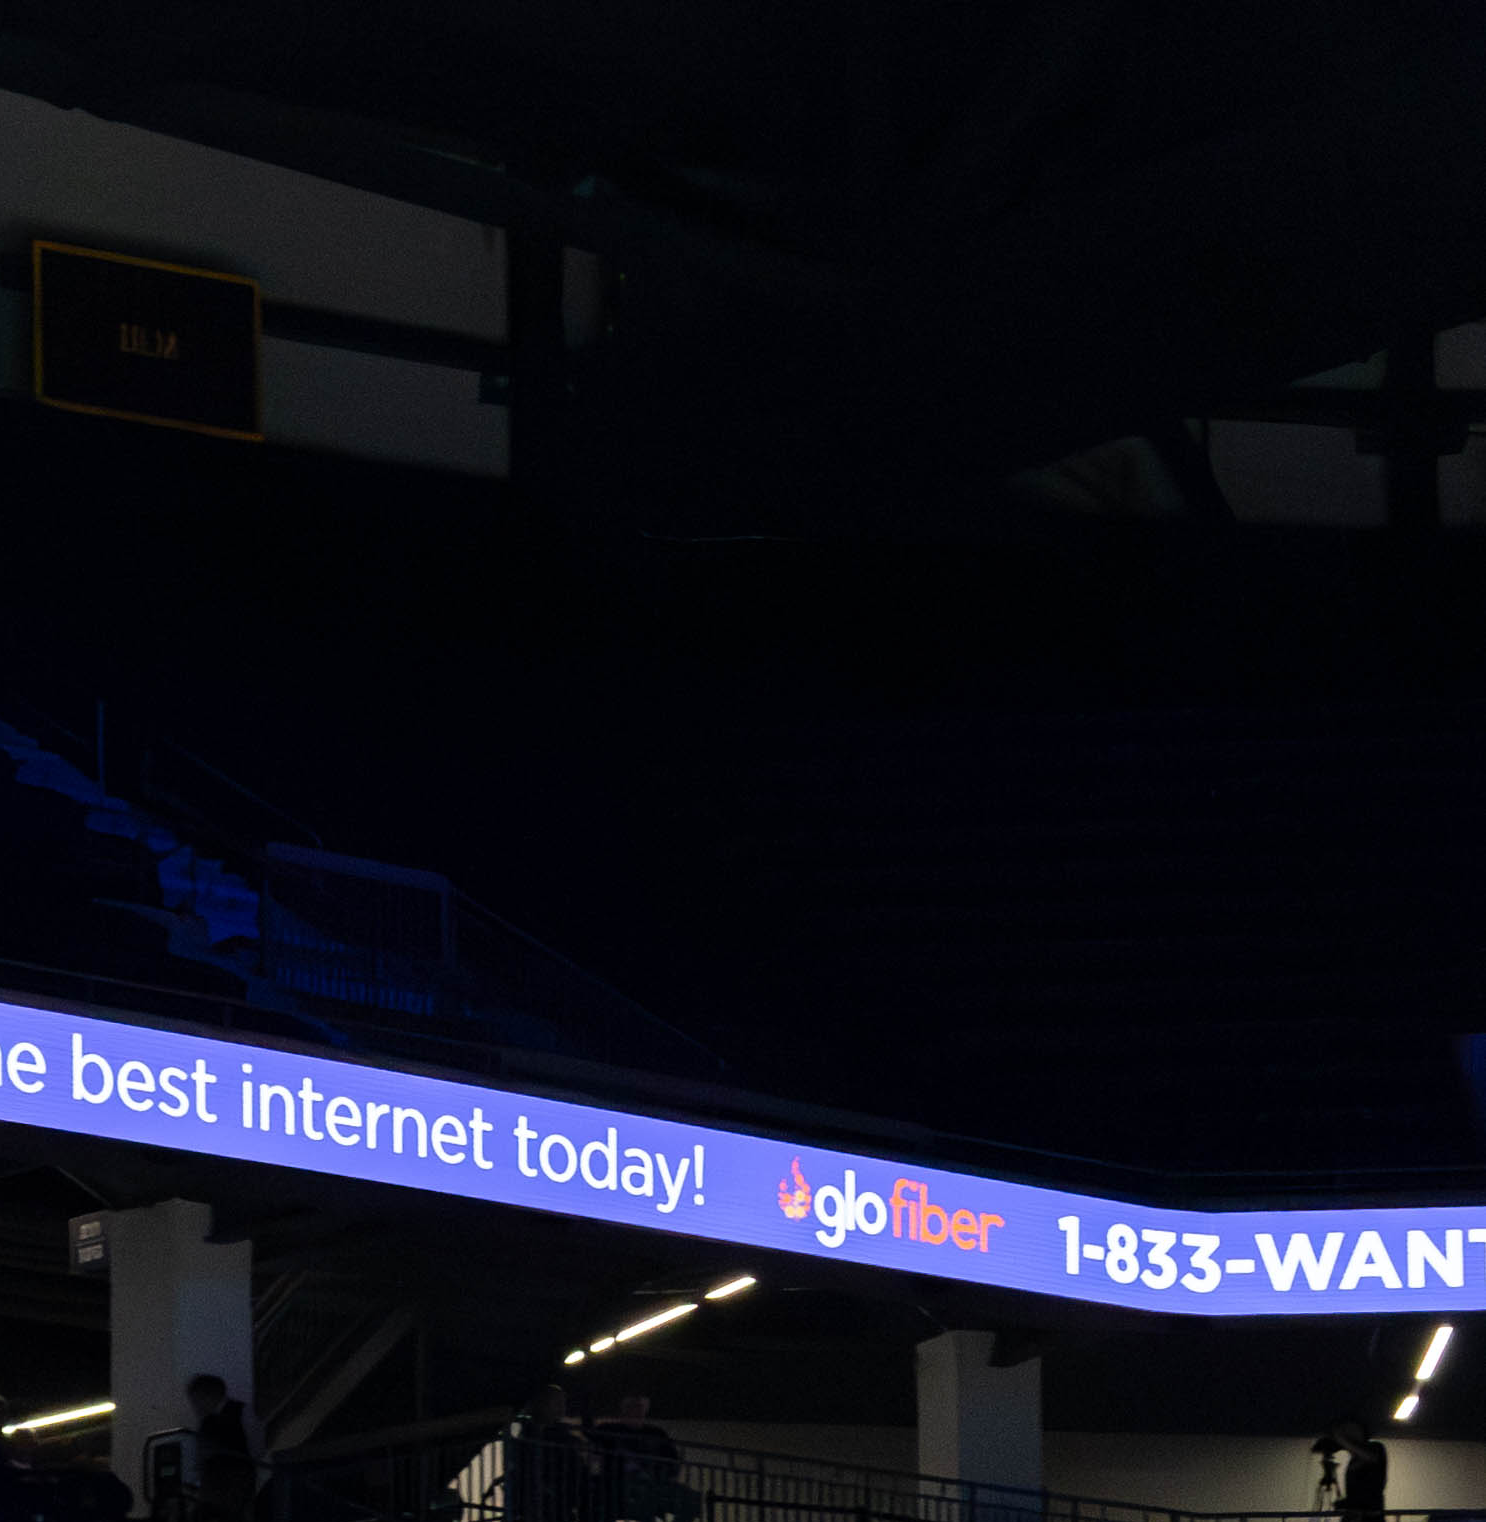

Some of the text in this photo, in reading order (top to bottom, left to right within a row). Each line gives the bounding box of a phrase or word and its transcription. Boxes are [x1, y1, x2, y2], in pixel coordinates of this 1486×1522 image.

[72, 1033, 218, 1125] best
[240, 1063, 494, 1170] internet
[514, 1115, 706, 1214] today!
